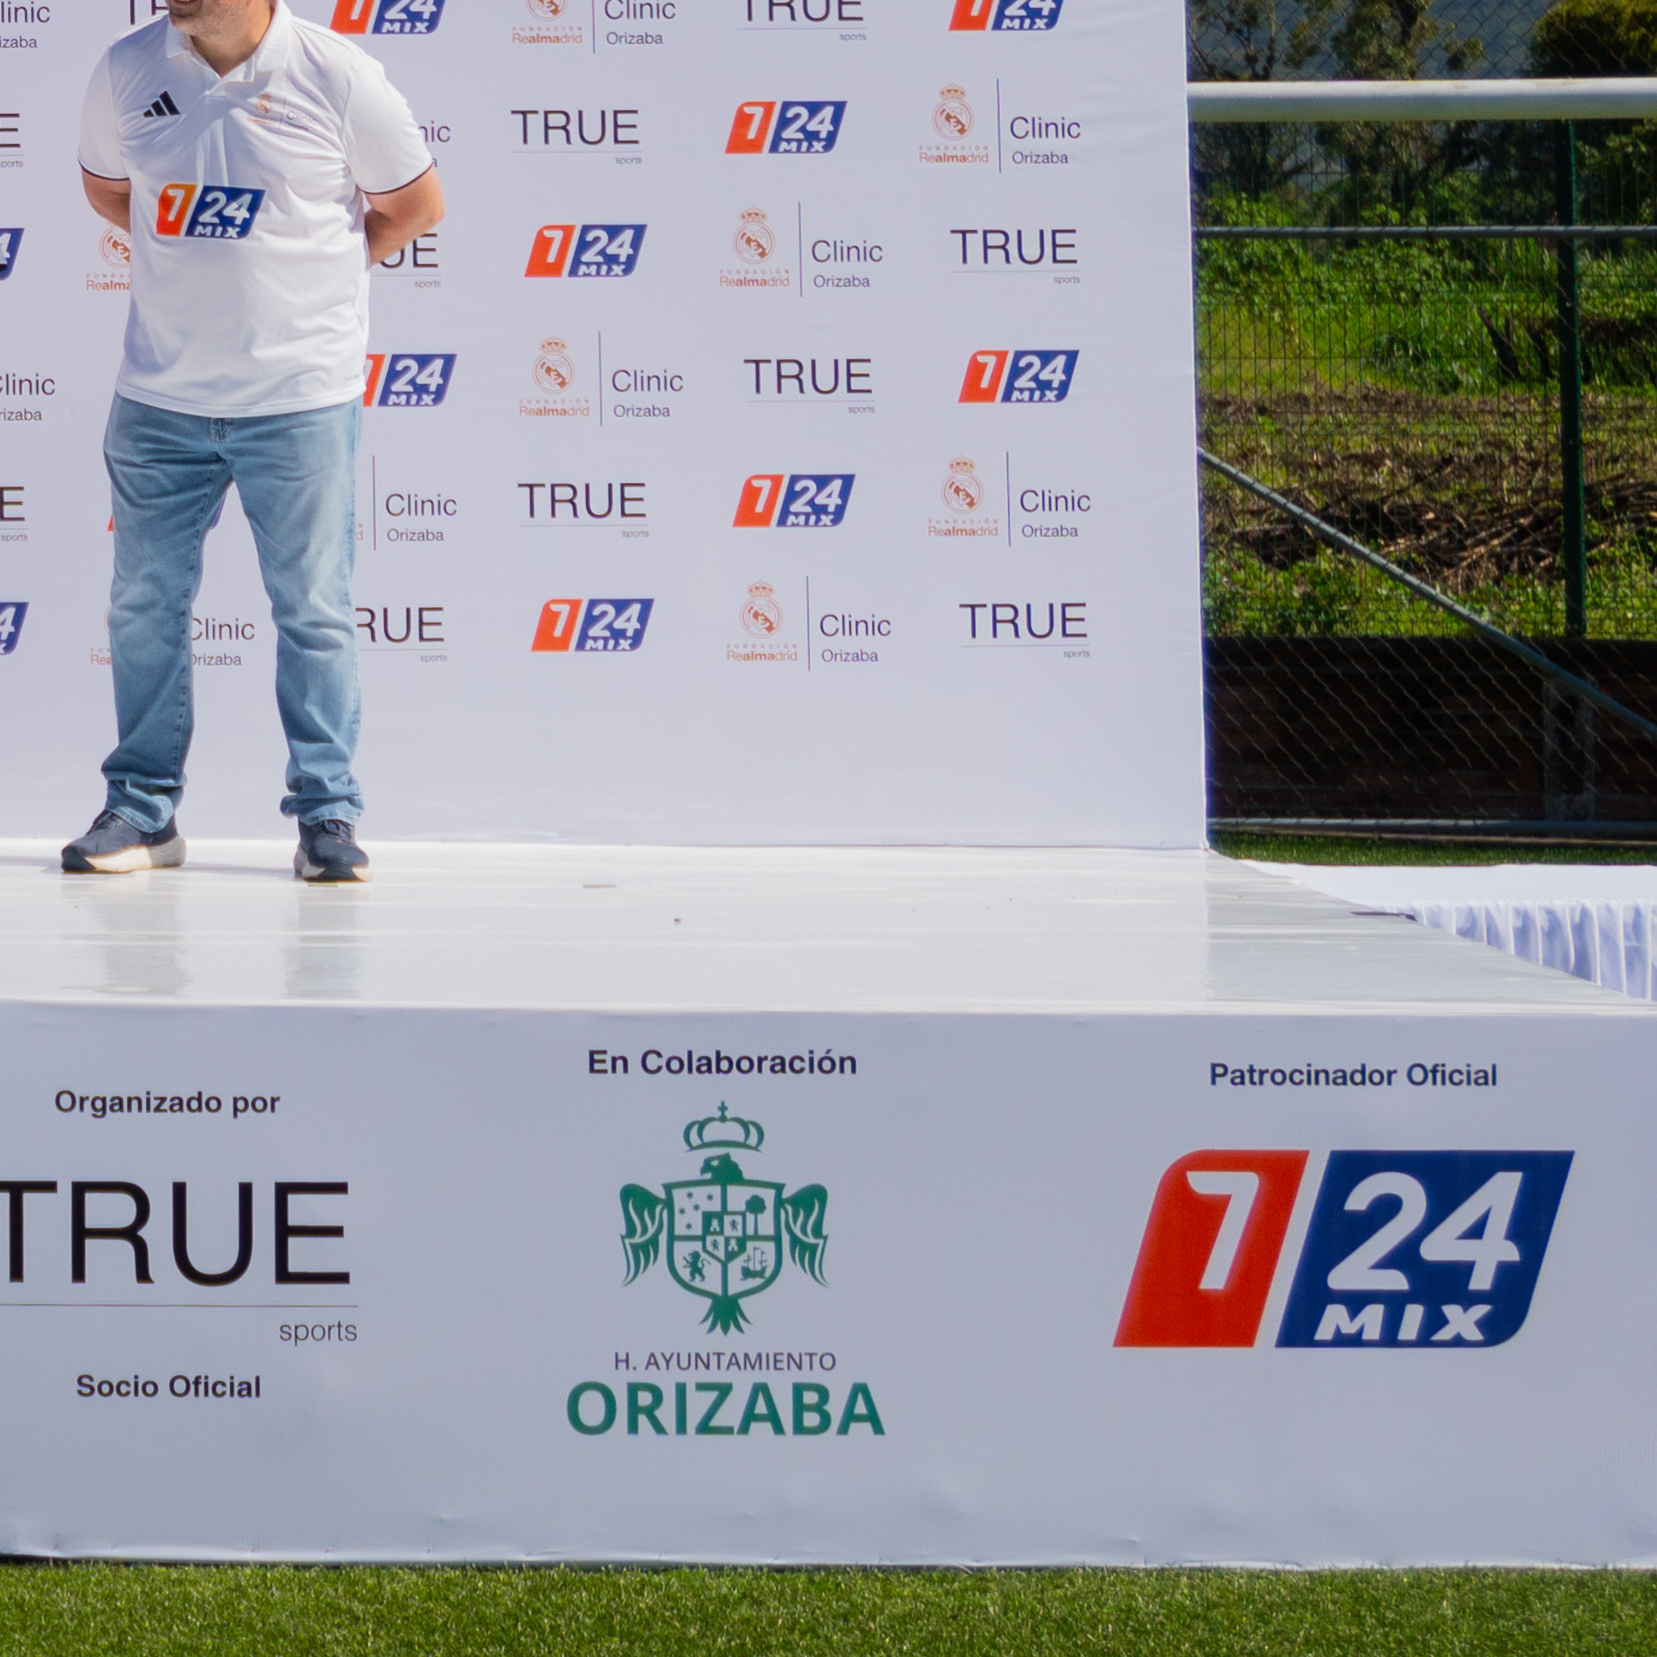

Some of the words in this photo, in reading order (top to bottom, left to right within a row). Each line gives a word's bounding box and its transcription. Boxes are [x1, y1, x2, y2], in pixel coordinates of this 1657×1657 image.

[513, 33, 582, 44] Realmadrid
[511, 110, 639, 145] TRUE
[1010, 116, 1080, 139] Clinic
[777, 140, 827, 151] MIX
[615, 157, 642, 165] sports
[920, 153, 988, 163] Realmadrid
[194, 225, 241, 238] MIX
[812, 240, 882, 262] Clinic
[950, 229, 1077, 265] TRUE
[813, 275, 870, 288] Orizaba
[612, 370, 683, 392] Clinic
[744, 359, 872, 394] TRUE
[614, 405, 670, 417] Orizaba
[386, 494, 456, 516] Clinic
[518, 483, 646, 518] TRUE
[1020, 490, 1090, 512] Clinic
[387, 528, 443, 541] Orizaba
[820, 614, 890, 637] Clinic
[959, 603, 1087, 639] TRUE
[583, 638, 633, 649] MIX
[1063, 650, 1090, 658] sports
[589, 1050, 628, 1074] En
[641, 1049, 856, 1074] Colaboración
[1211, 1063, 1397, 1086] Patrocinador
[1407, 1063, 1496, 1086] Oficial
[55, 1090, 222, 1118] Organizado
[233, 1096, 280, 1119] por
[280, 1321, 357, 1346] sports
[1313, 1304, 1494, 1341] MIX
[615, 1352, 636, 1370] H.
[645, 1352, 836, 1371] AYUNTAMIENTO
[77, 1375, 158, 1397] Socio
[169, 1375, 260, 1398] Oficial
[567, 1381, 885, 1435] ORIZABA
